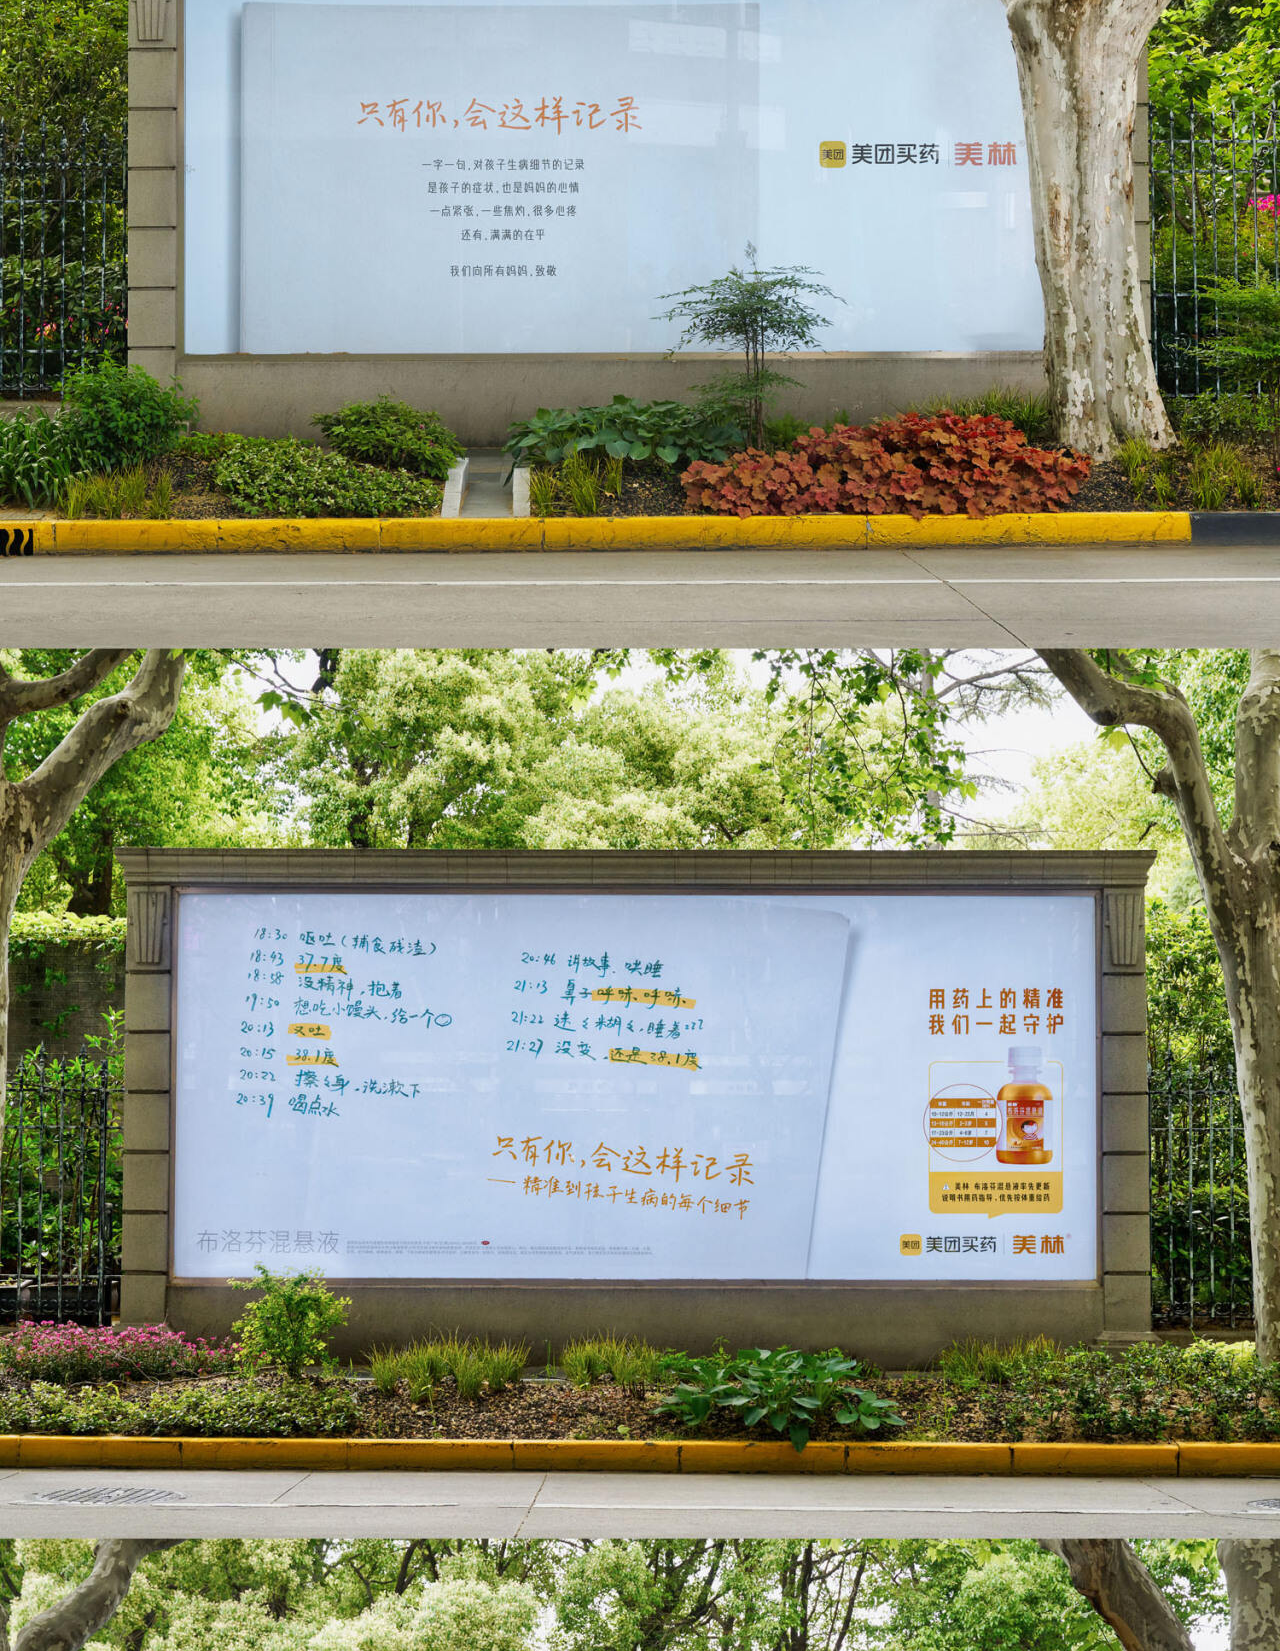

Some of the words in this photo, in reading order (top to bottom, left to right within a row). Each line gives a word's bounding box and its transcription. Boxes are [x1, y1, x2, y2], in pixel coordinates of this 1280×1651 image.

[356, 96, 643, 135] 只有你，会这样记录
[822, 148, 844, 161] 美团
[851, 142, 940, 165] 美团买药
[954, 141, 1017, 166] 美林
[421, 158, 585, 171] 一字一句，对孩子生病细节的记录
[427, 181, 580, 194] 是孩子的症状，也是妈妈的心情
[449, 264, 558, 277] 我们向所有妈妈，致敬
[254, 927, 288, 941] 18:30
[250, 949, 284, 966] 18:43
[298, 951, 348, 975] 37.7度
[521, 951, 556, 965] 20:46
[247, 968, 285, 984] 18:58
[513, 979, 548, 994] 21:13
[245, 993, 280, 1011] 19:50
[928, 987, 1065, 1010] 用药上的精准
[511, 1010, 544, 1024] 21:22
[928, 1013, 1065, 1036] 我们一起守护
[240, 1021, 274, 1037] 20:13
[294, 1024, 326, 1037] 又吐
[240, 1047, 276, 1060] 20:15
[295, 1048, 339, 1068] 38.1度
[506, 1038, 544, 1059] 21:27
[239, 1069, 276, 1082] 20:22
[236, 1093, 274, 1118] 20:39
[288, 1093, 340, 1117] 喝点水
[491, 1135, 755, 1187] 只有你，会这样记录
[196, 1229, 341, 1255] 布洛芬混悬液
[926, 1235, 997, 1253] 美团买药
[1012, 1234, 1065, 1254] 美林
